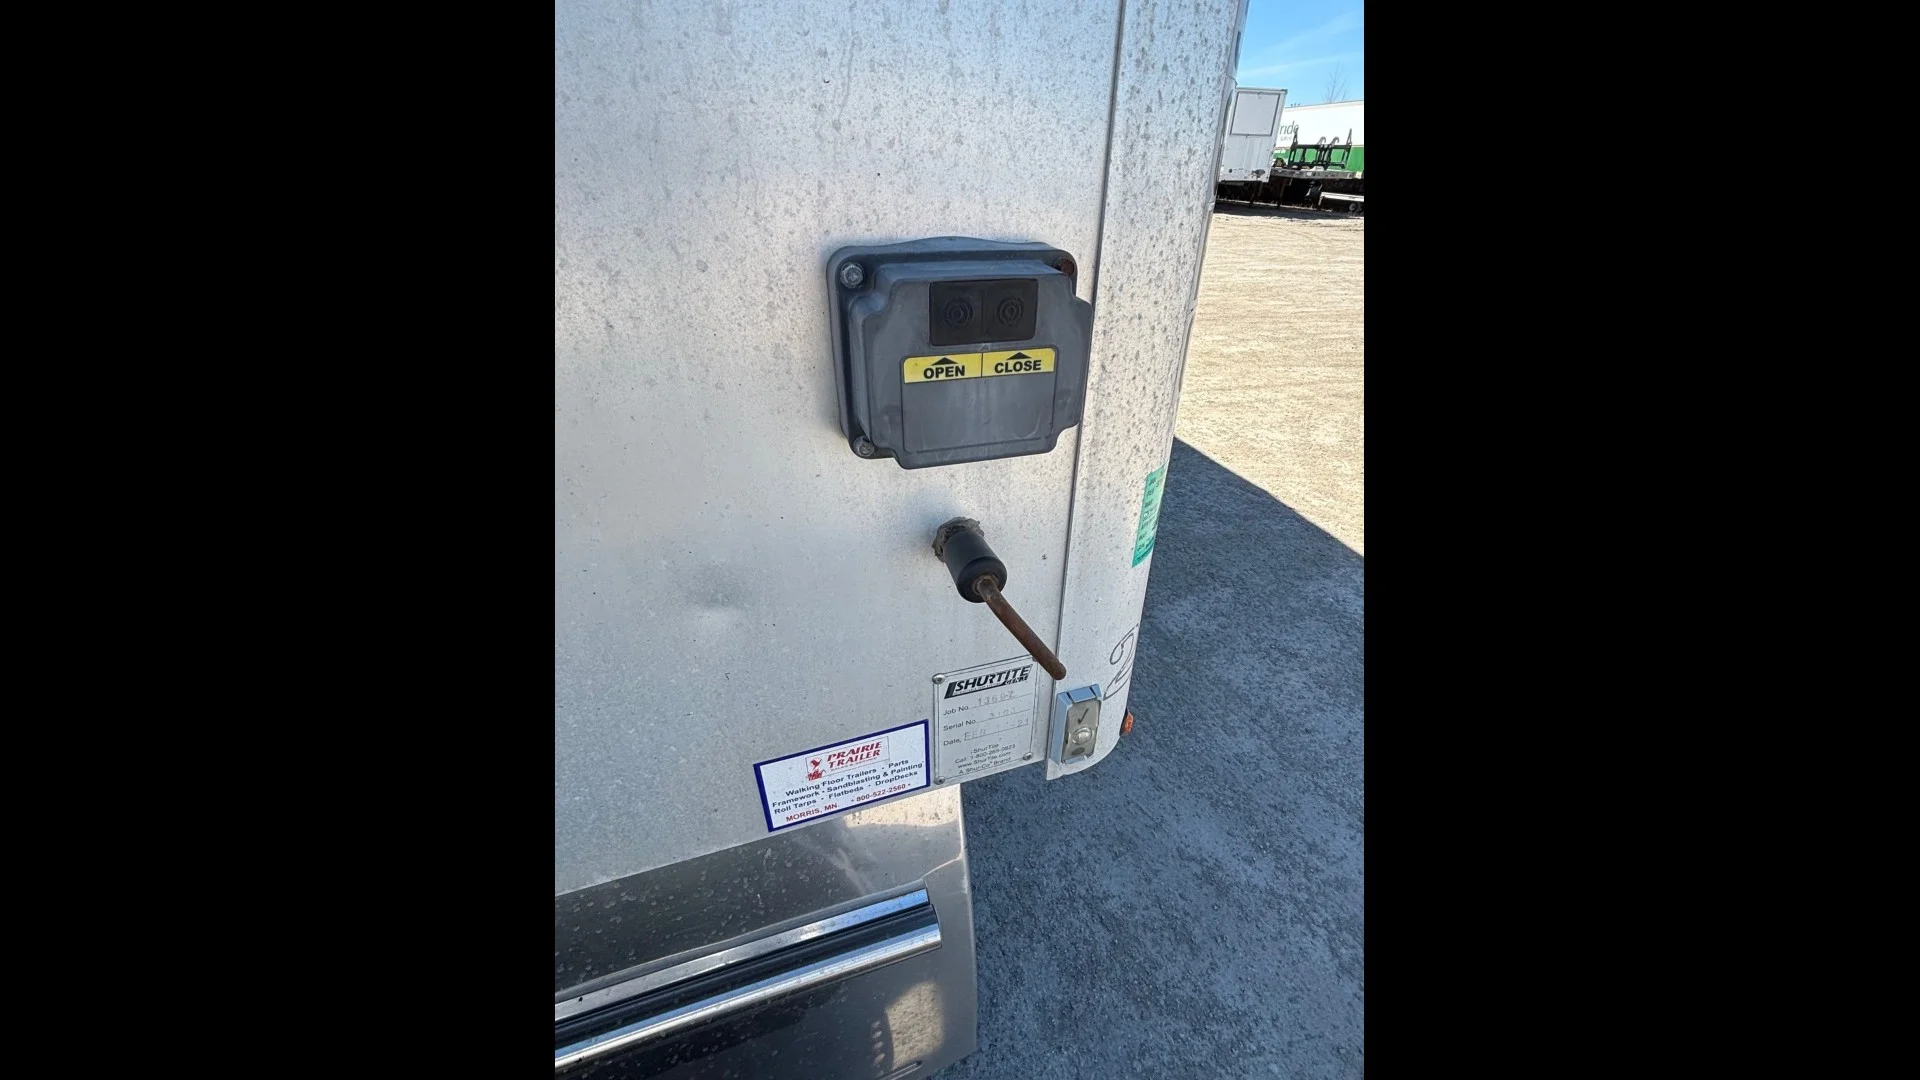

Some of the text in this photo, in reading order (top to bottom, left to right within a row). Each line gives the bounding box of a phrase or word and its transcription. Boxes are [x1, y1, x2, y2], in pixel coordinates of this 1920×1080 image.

[923, 359, 1042, 379] OPEN CLOSE
[943, 708, 957, 716] Job
[943, 721, 964, 731] Serial
[827, 741, 882, 762] PRAIRIE
[828, 749, 881, 769] TRAILER
[772, 791, 820, 808] Framework
[826, 774, 881, 793] Sandblasting
[890, 763, 923, 775] Painting
[785, 759, 909, 797] Walking Floor Trailers Parts
[774, 771, 918, 815] Roll Tarps Flatbeds DropDecks
[856, 783, 906, 802] 800-522-2560
